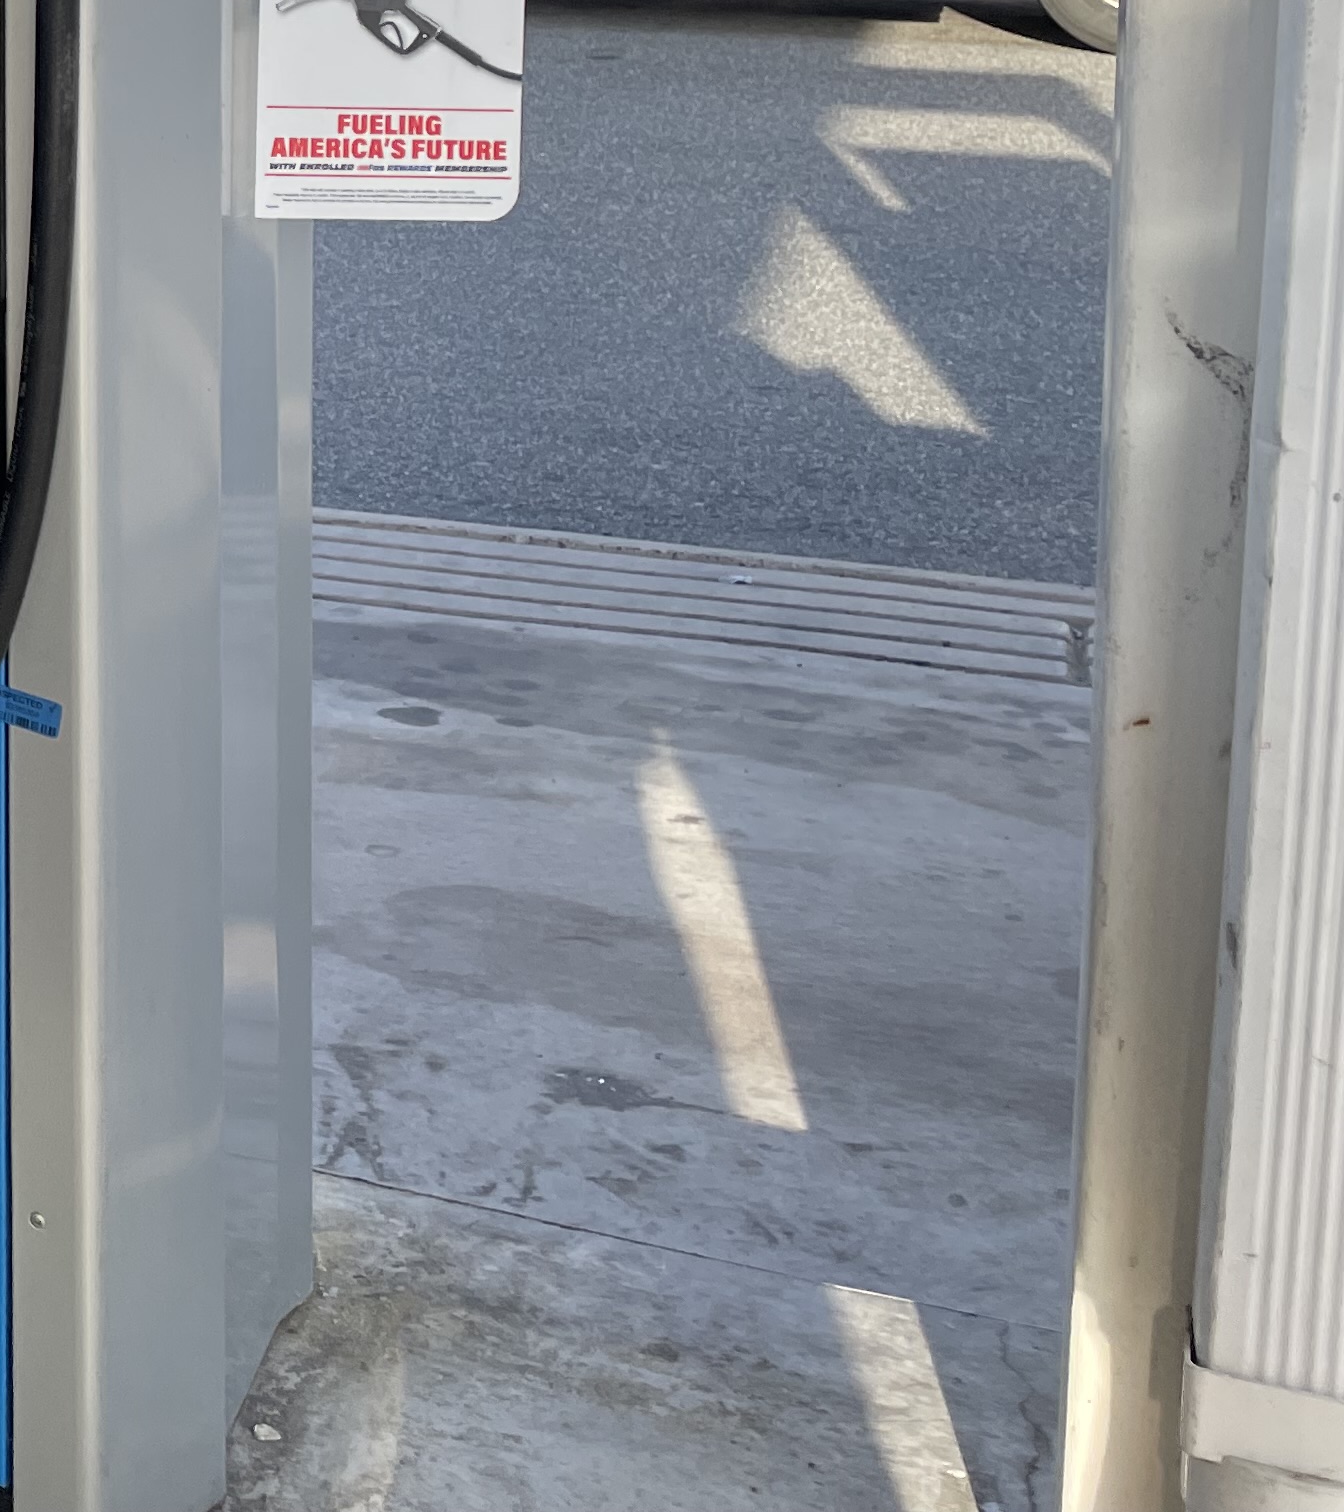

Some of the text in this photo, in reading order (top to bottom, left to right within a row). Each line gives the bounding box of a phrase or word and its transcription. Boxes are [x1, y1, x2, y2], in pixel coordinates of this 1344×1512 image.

[337, 114, 442, 136] FUELING
[271, 137, 507, 161] AMERICA'S FUTURE
